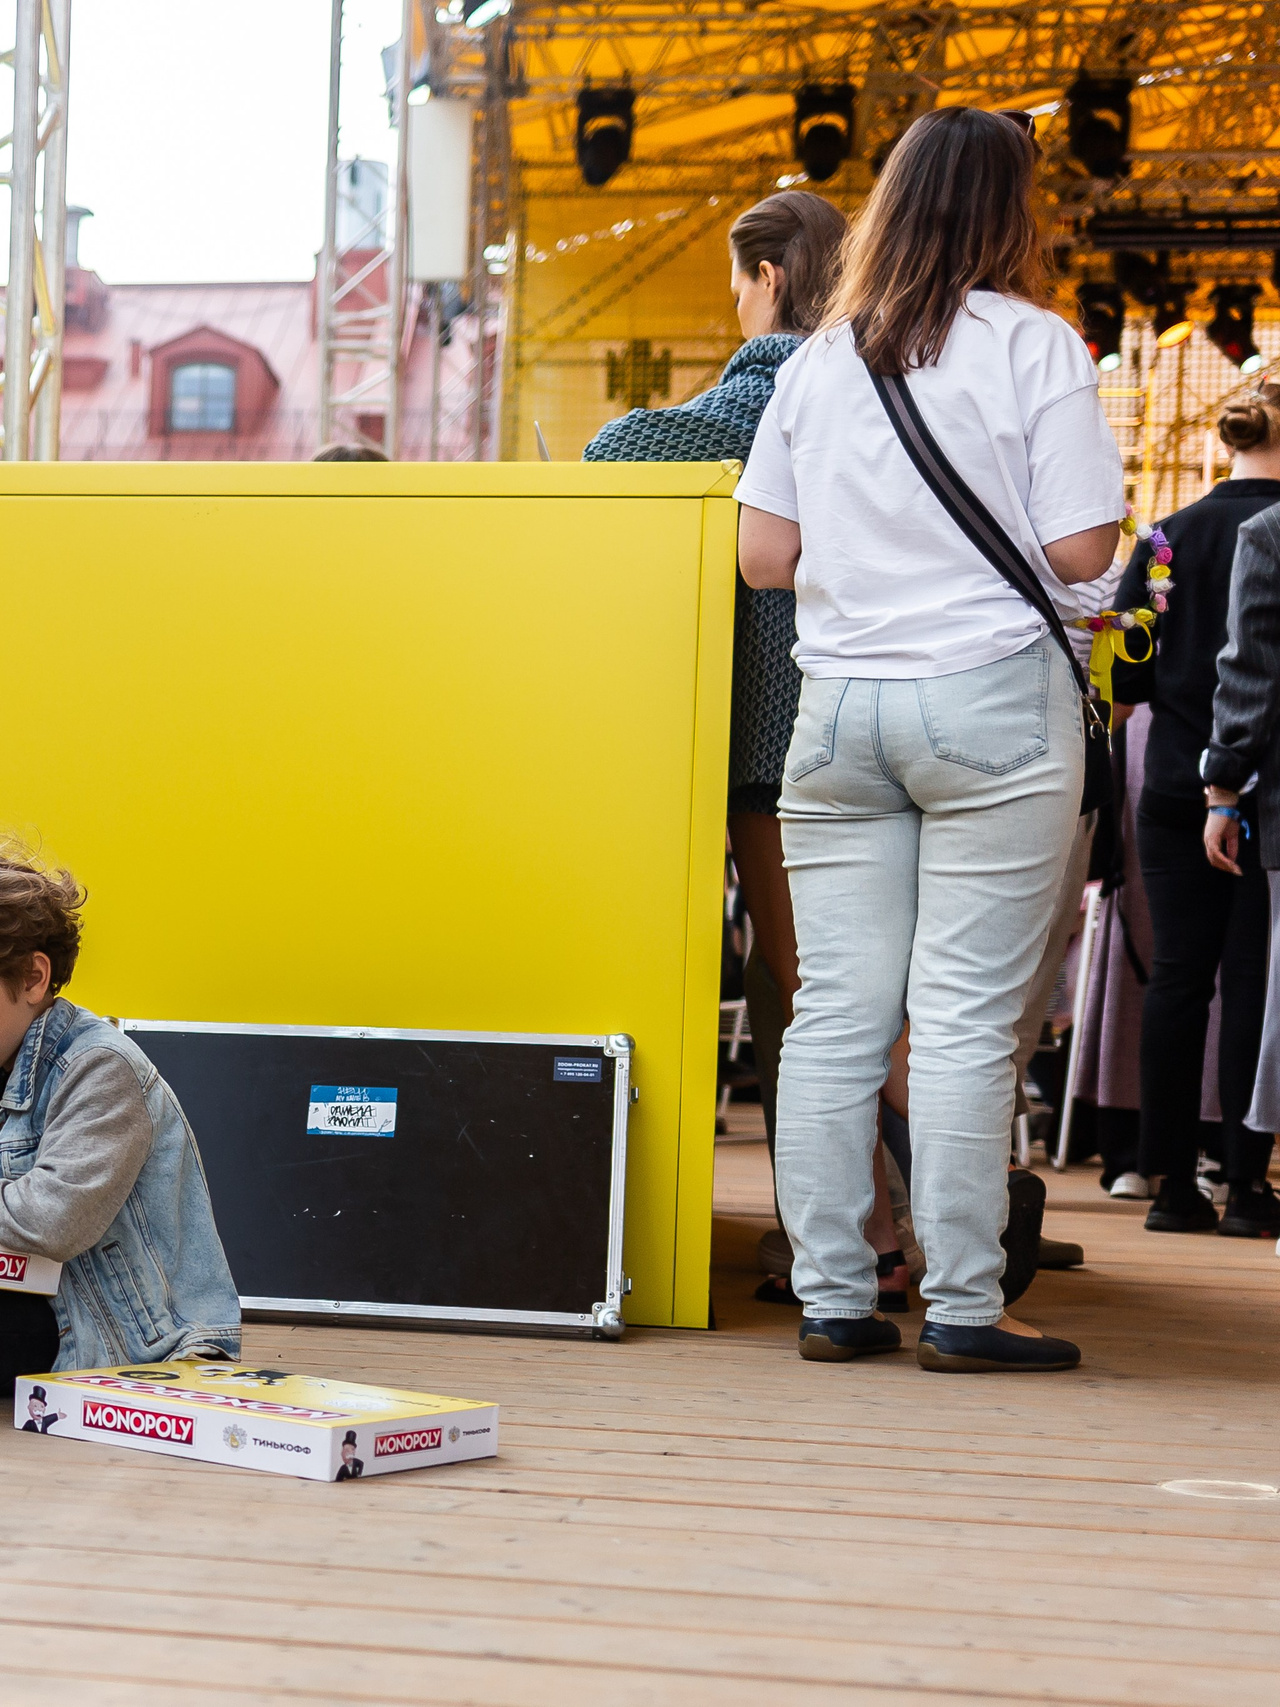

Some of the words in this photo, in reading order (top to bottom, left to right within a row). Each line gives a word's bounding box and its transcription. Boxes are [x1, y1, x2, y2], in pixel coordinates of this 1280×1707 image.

[85, 1404, 192, 1441] MONOPOLY
[252, 1437, 312, 1455] ТИНЬКОФФ
[376, 1429, 442, 1455] MONOPOLY
